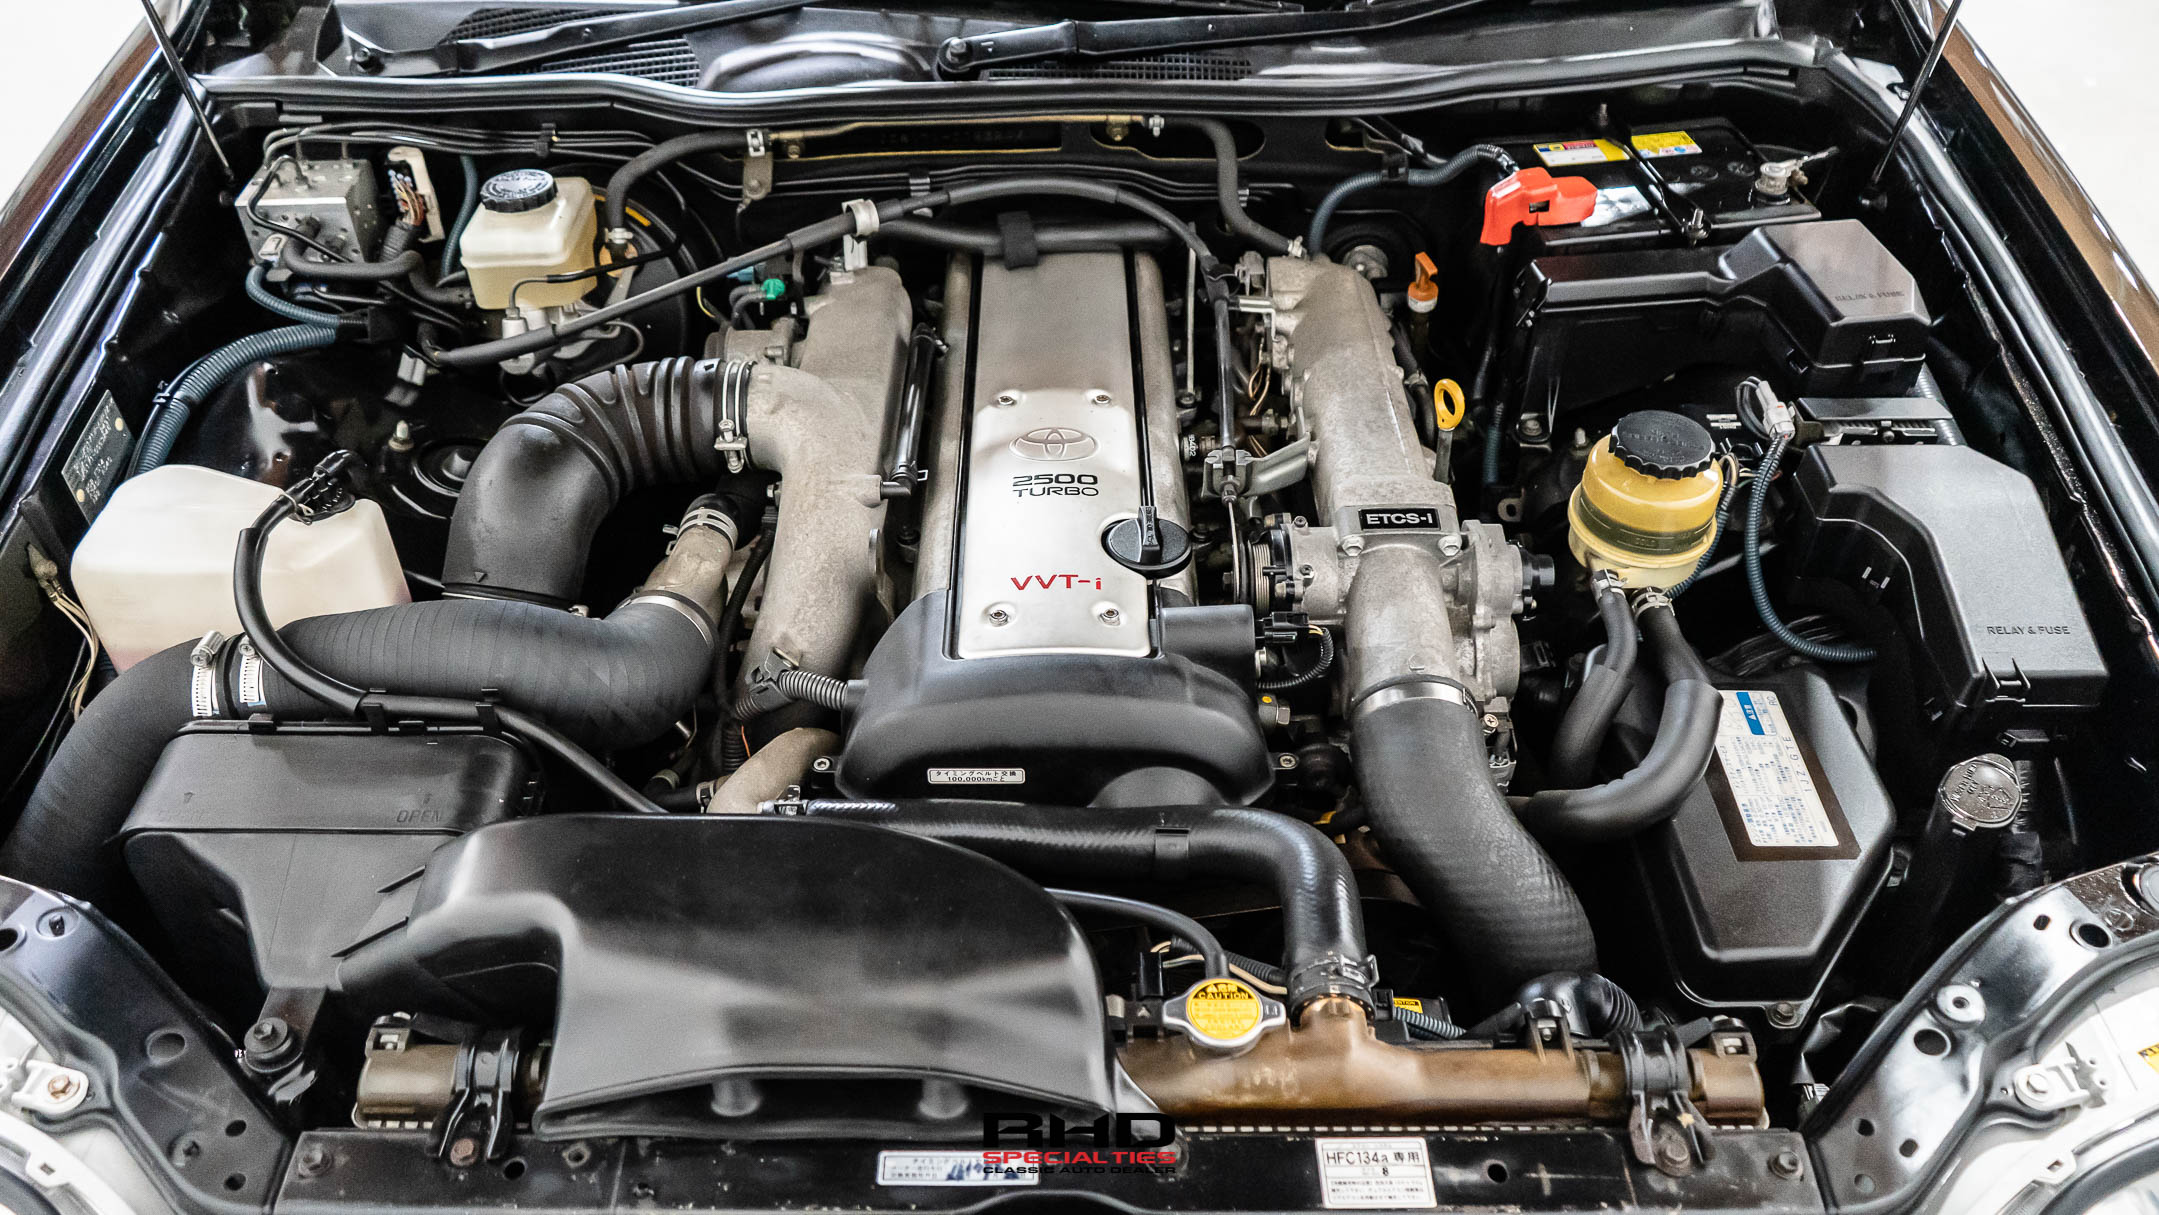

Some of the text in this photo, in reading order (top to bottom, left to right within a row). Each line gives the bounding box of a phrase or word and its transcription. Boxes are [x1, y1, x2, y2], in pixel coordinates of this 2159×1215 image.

[1013, 473, 1099, 486] 2500
[1013, 486, 1099, 497] TURBO
[1011, 574, 1102, 590] VVT-i
[1986, 626, 2071, 635] RELAY & FUSE
[396, 809, 440, 823] OPEN
[1326, 1151, 1389, 1165] HFC134a
